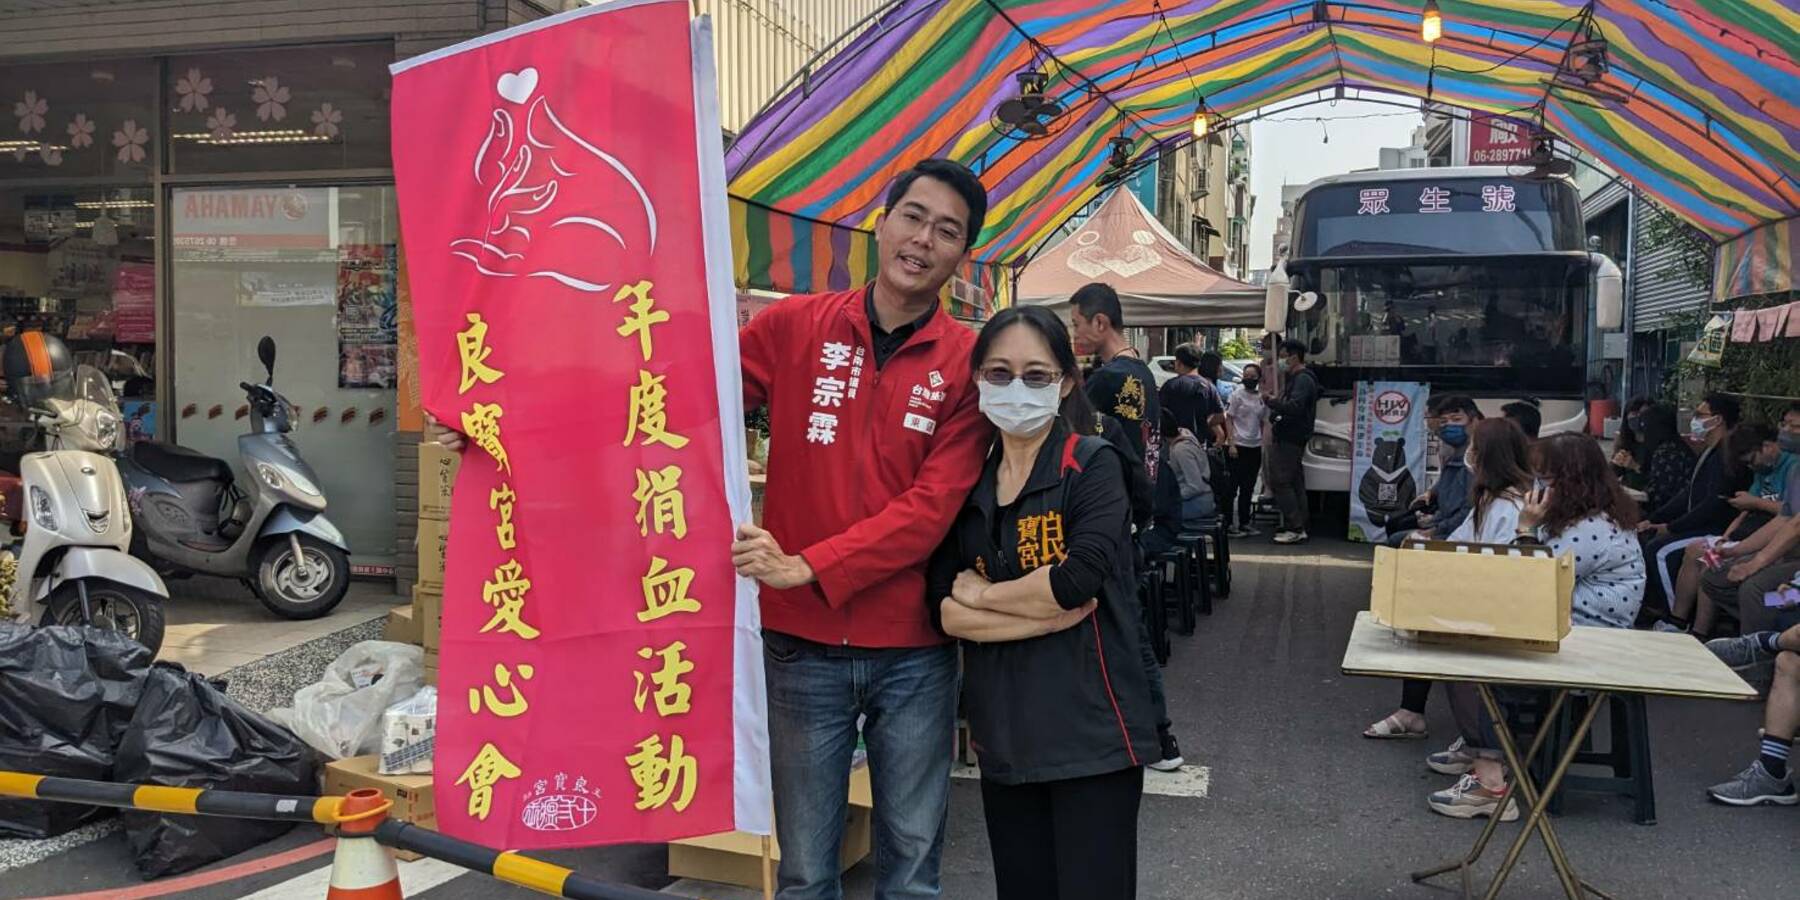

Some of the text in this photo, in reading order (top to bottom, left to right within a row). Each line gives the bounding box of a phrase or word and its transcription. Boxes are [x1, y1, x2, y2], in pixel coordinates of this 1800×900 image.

[1358, 185, 1516, 215] 眾生號
[806, 341, 852, 445] 李宗霖
[847, 345, 866, 400] 台南市議員
[453, 312, 541, 822] 良寶宮愛心會
[612, 279, 702, 813] 年度捐血活動
